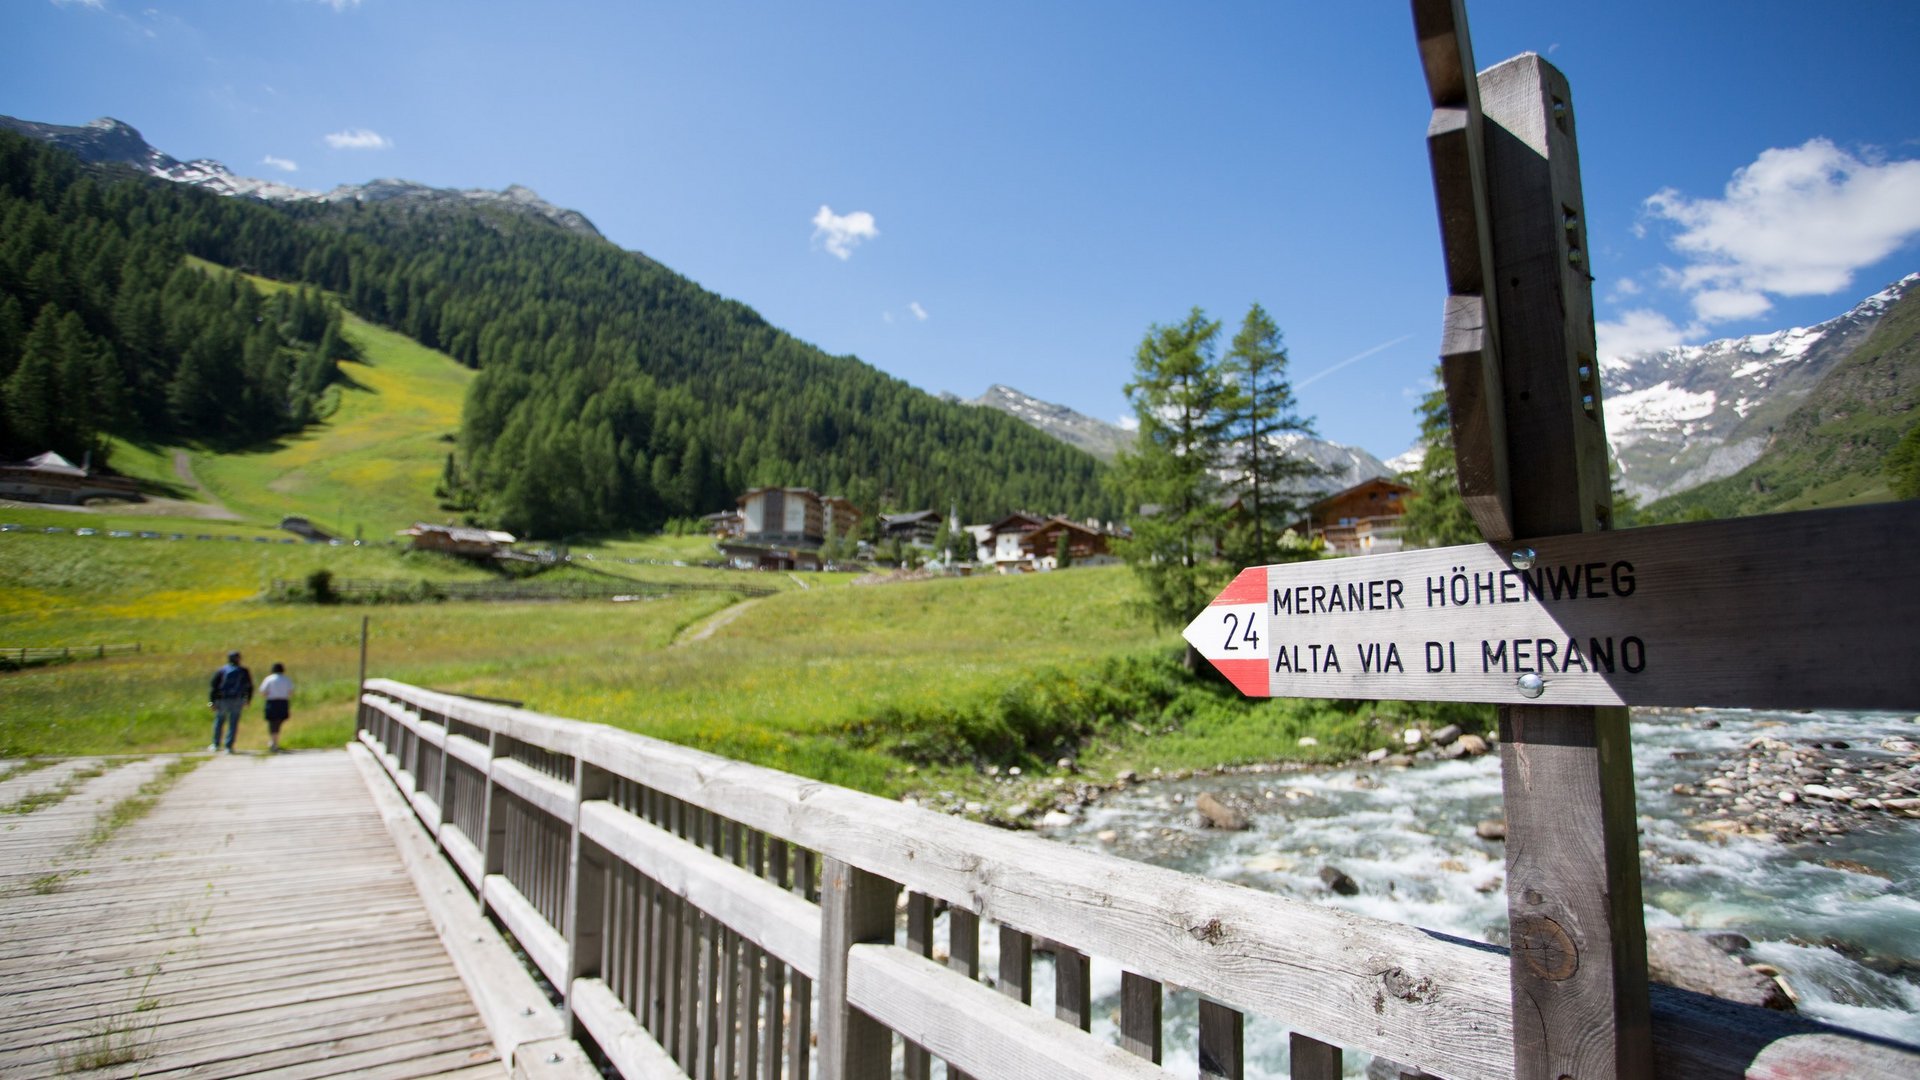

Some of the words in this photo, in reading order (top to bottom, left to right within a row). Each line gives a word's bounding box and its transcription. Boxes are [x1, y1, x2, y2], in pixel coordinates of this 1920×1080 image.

[1273, 579, 1405, 615] MERANER
[1426, 560, 1636, 606] HÖHENWEG
[1223, 612, 1260, 651] 24
[1275, 644, 1342, 673] ALTA
[1358, 642, 1404, 673] VIA
[1426, 641, 1456, 673] DI
[1482, 636, 1646, 673] MERANO
